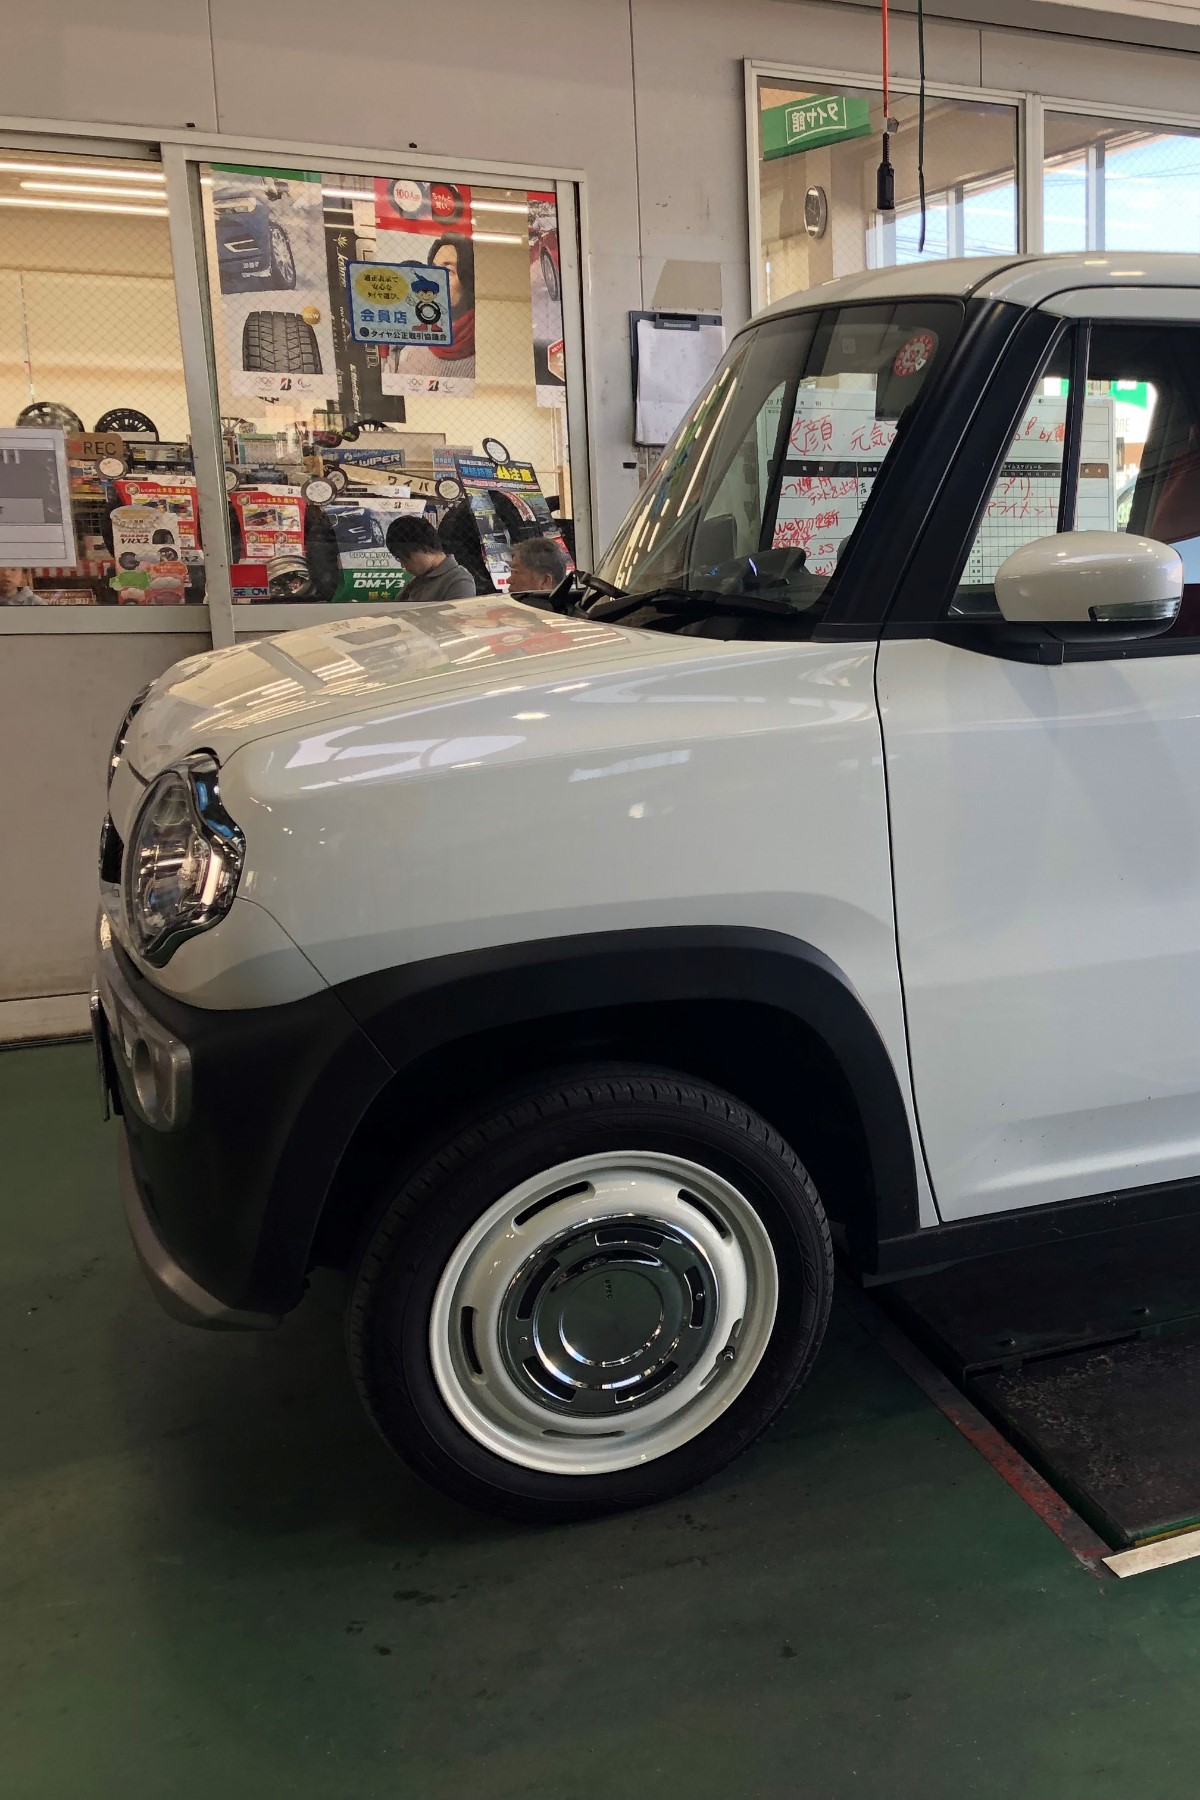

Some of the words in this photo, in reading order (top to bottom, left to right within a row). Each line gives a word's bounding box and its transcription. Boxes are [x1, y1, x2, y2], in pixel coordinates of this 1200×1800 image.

[360, 308, 407, 324] 会員店
[370, 330, 447, 341] タイヤ公正取引協議会
[83, 441, 117, 456] REC
[359, 453, 401, 467] WIPER
[120, 537, 150, 545] VRX2
[353, 579, 406, 589] DM-V3
